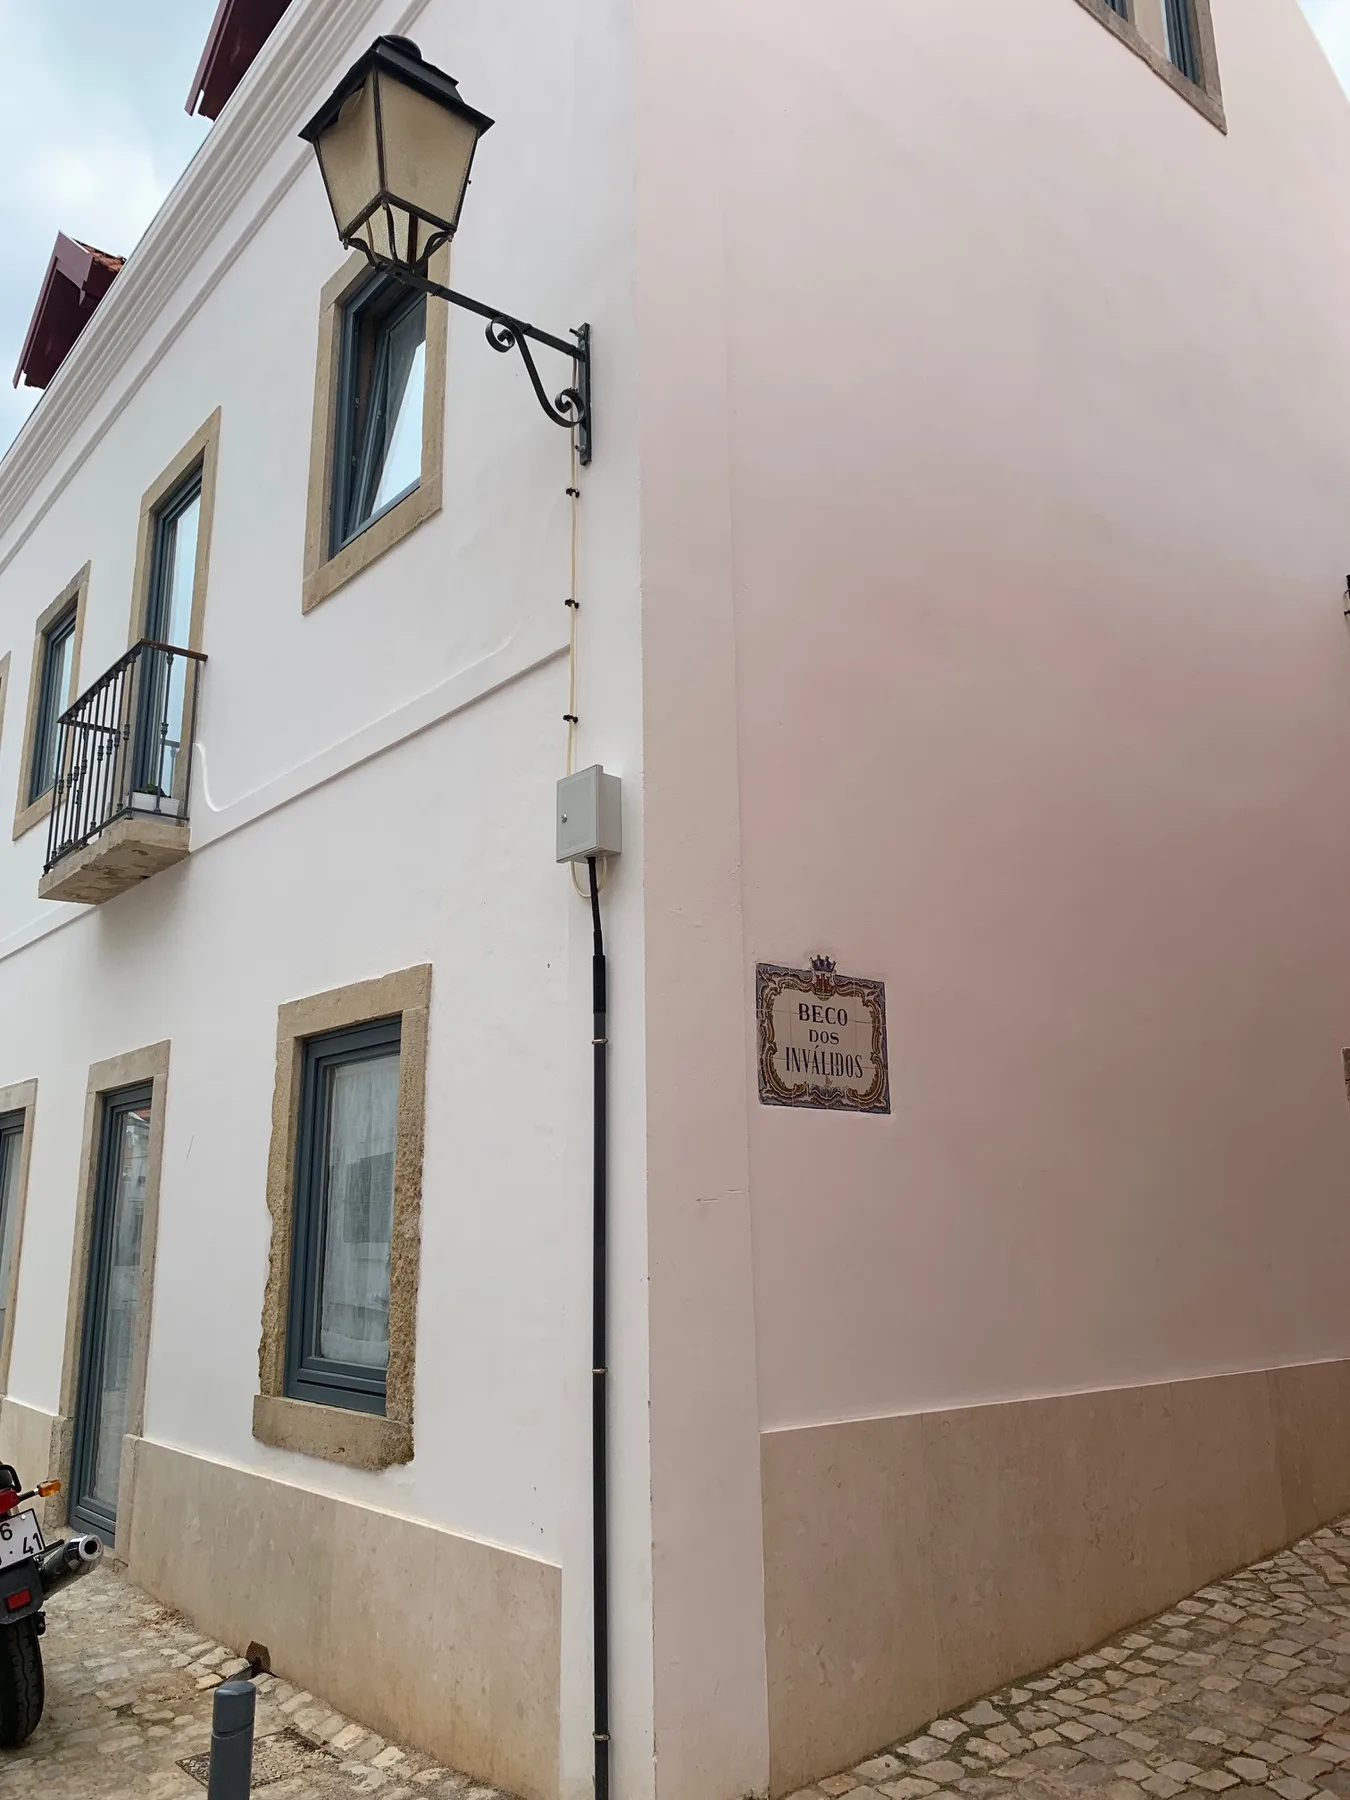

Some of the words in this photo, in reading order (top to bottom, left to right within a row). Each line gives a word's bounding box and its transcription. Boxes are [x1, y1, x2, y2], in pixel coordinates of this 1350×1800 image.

[798, 1002, 847, 1026] BECO
[809, 1029, 839, 1044] DOS
[786, 1045, 863, 1078] INVÁLIDOS
